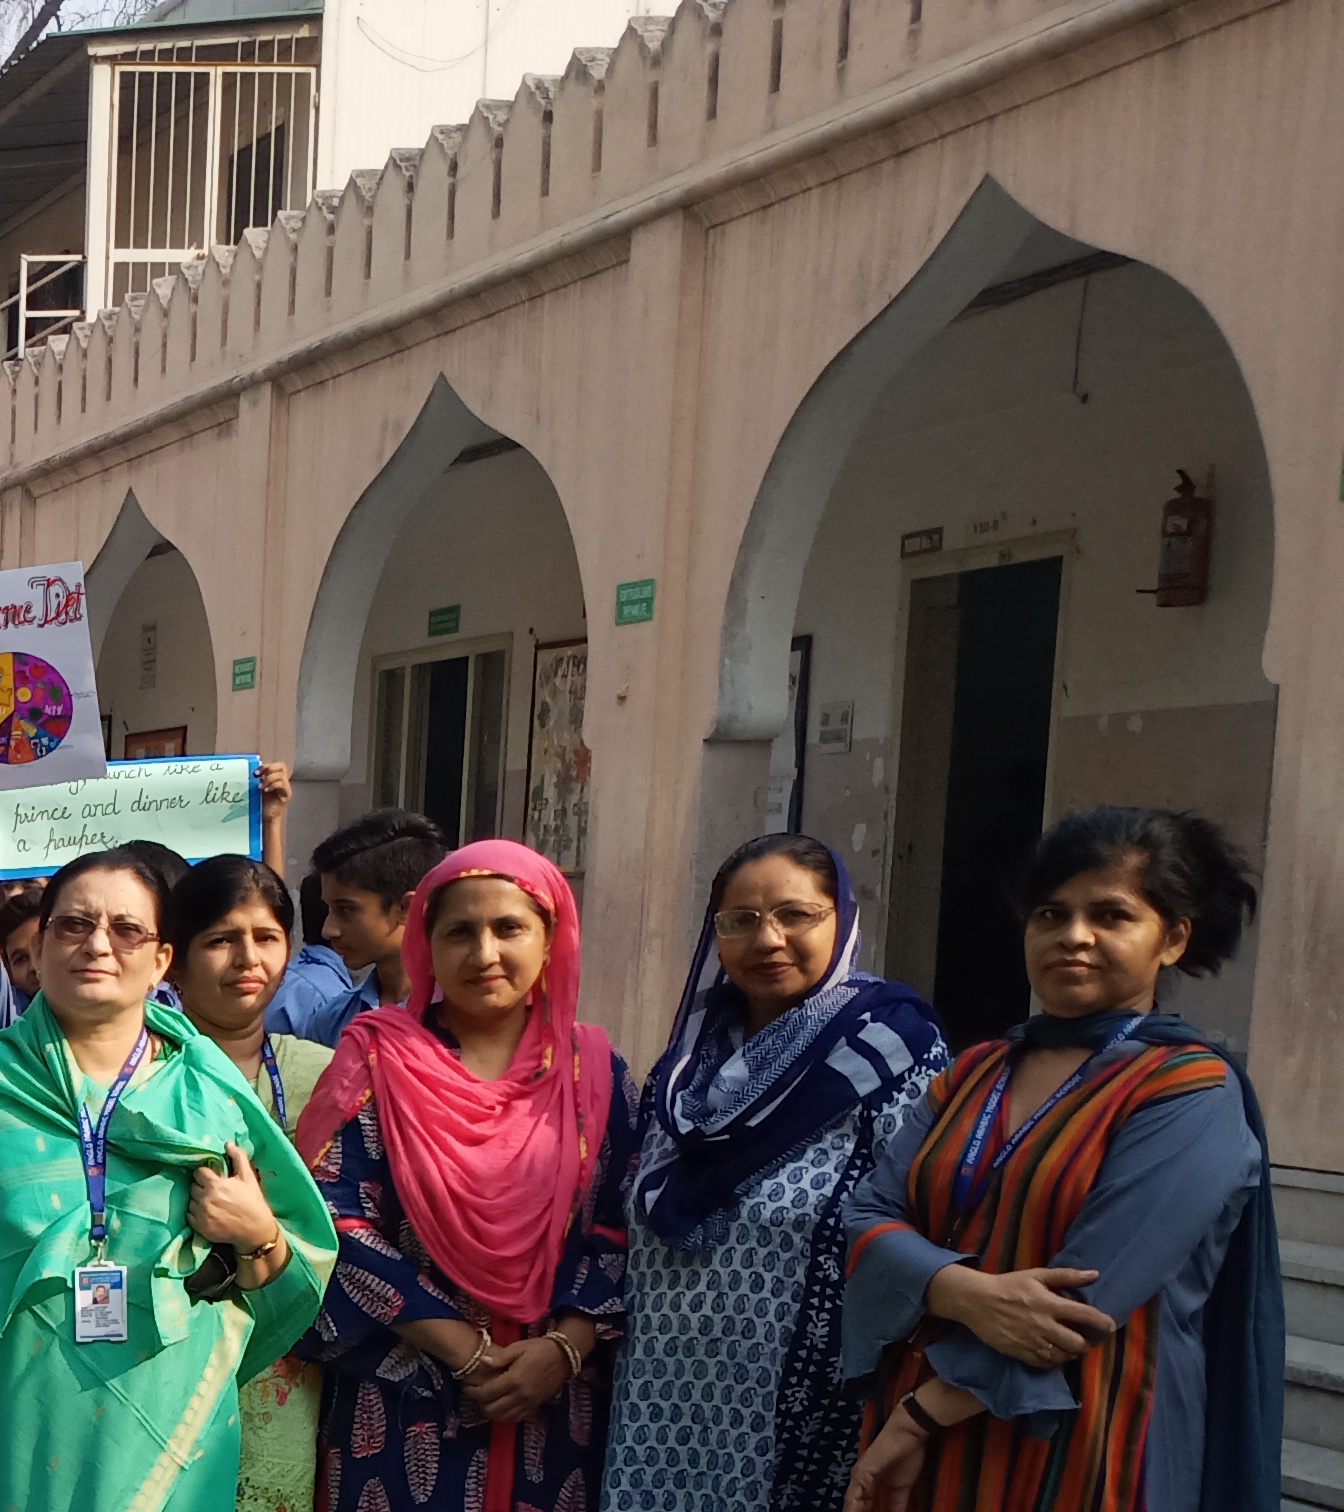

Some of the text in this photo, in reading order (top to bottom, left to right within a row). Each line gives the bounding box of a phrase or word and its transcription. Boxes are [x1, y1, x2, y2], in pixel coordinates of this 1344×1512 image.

[28, 576, 85, 628] Diet
[12, 781, 243, 833] prince and dinner like
[16, 838, 31, 853] a
